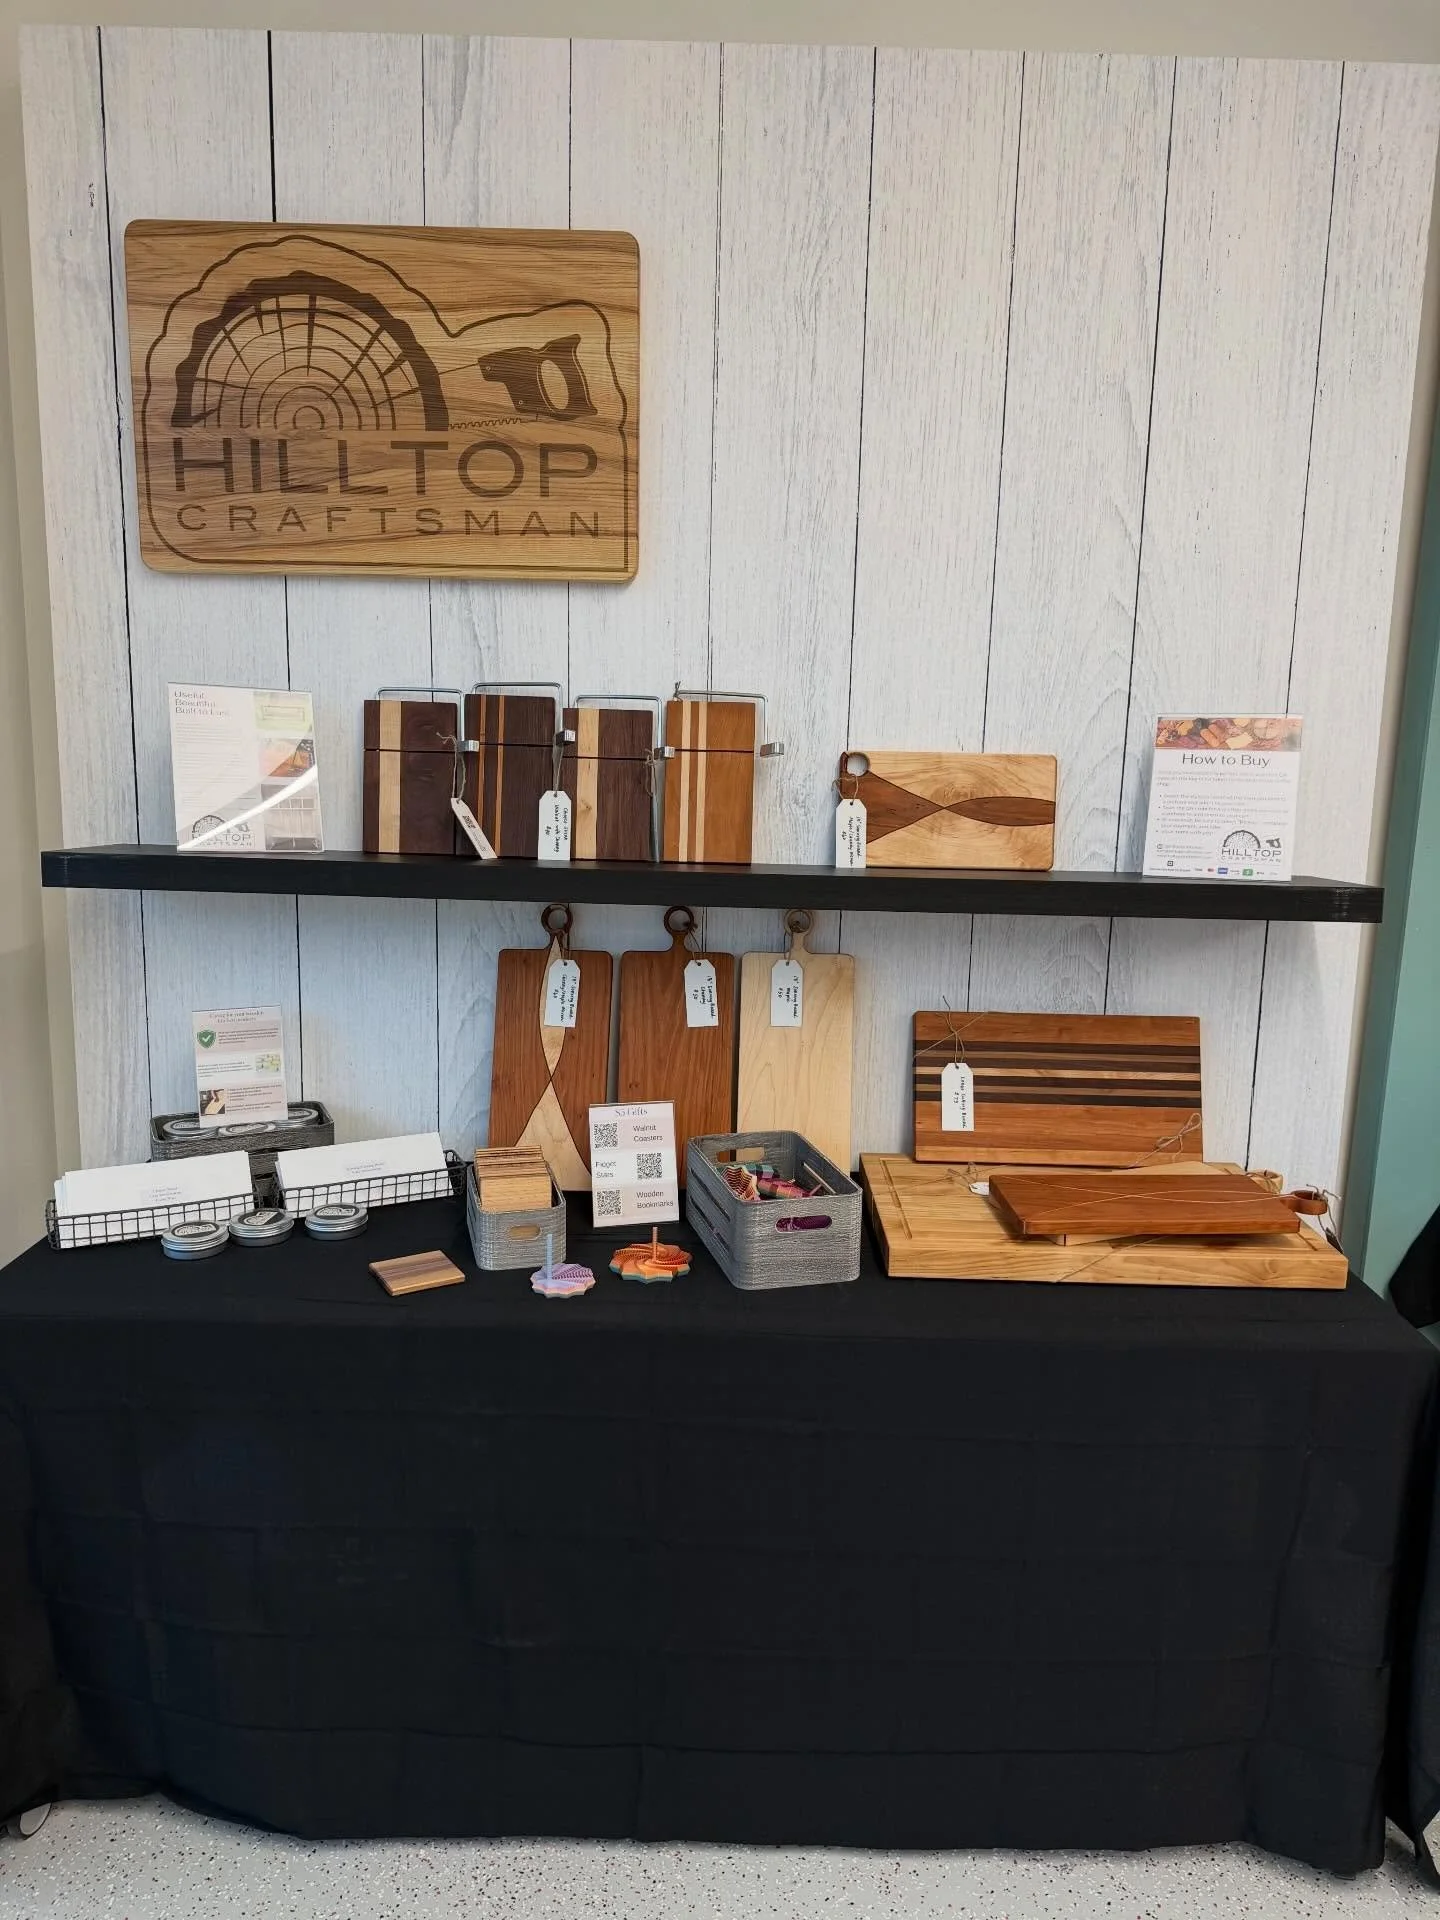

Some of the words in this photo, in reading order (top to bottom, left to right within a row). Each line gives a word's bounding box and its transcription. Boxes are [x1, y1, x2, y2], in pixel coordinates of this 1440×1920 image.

[172, 437, 598, 498] HILLTOP
[176, 504, 600, 539] CRAFTSMAN
[1182, 753, 1217, 765] How
[1221, 755, 1236, 766] to
[1241, 755, 1270, 769] Buy
[1221, 848, 1282, 858] HILLTOP
[633, 1124, 657, 1132] Walnut
[633, 1135, 664, 1143] Coasters
[636, 1190, 664, 1198] Wooden
[637, 1201, 674, 1209] Bookmarks
